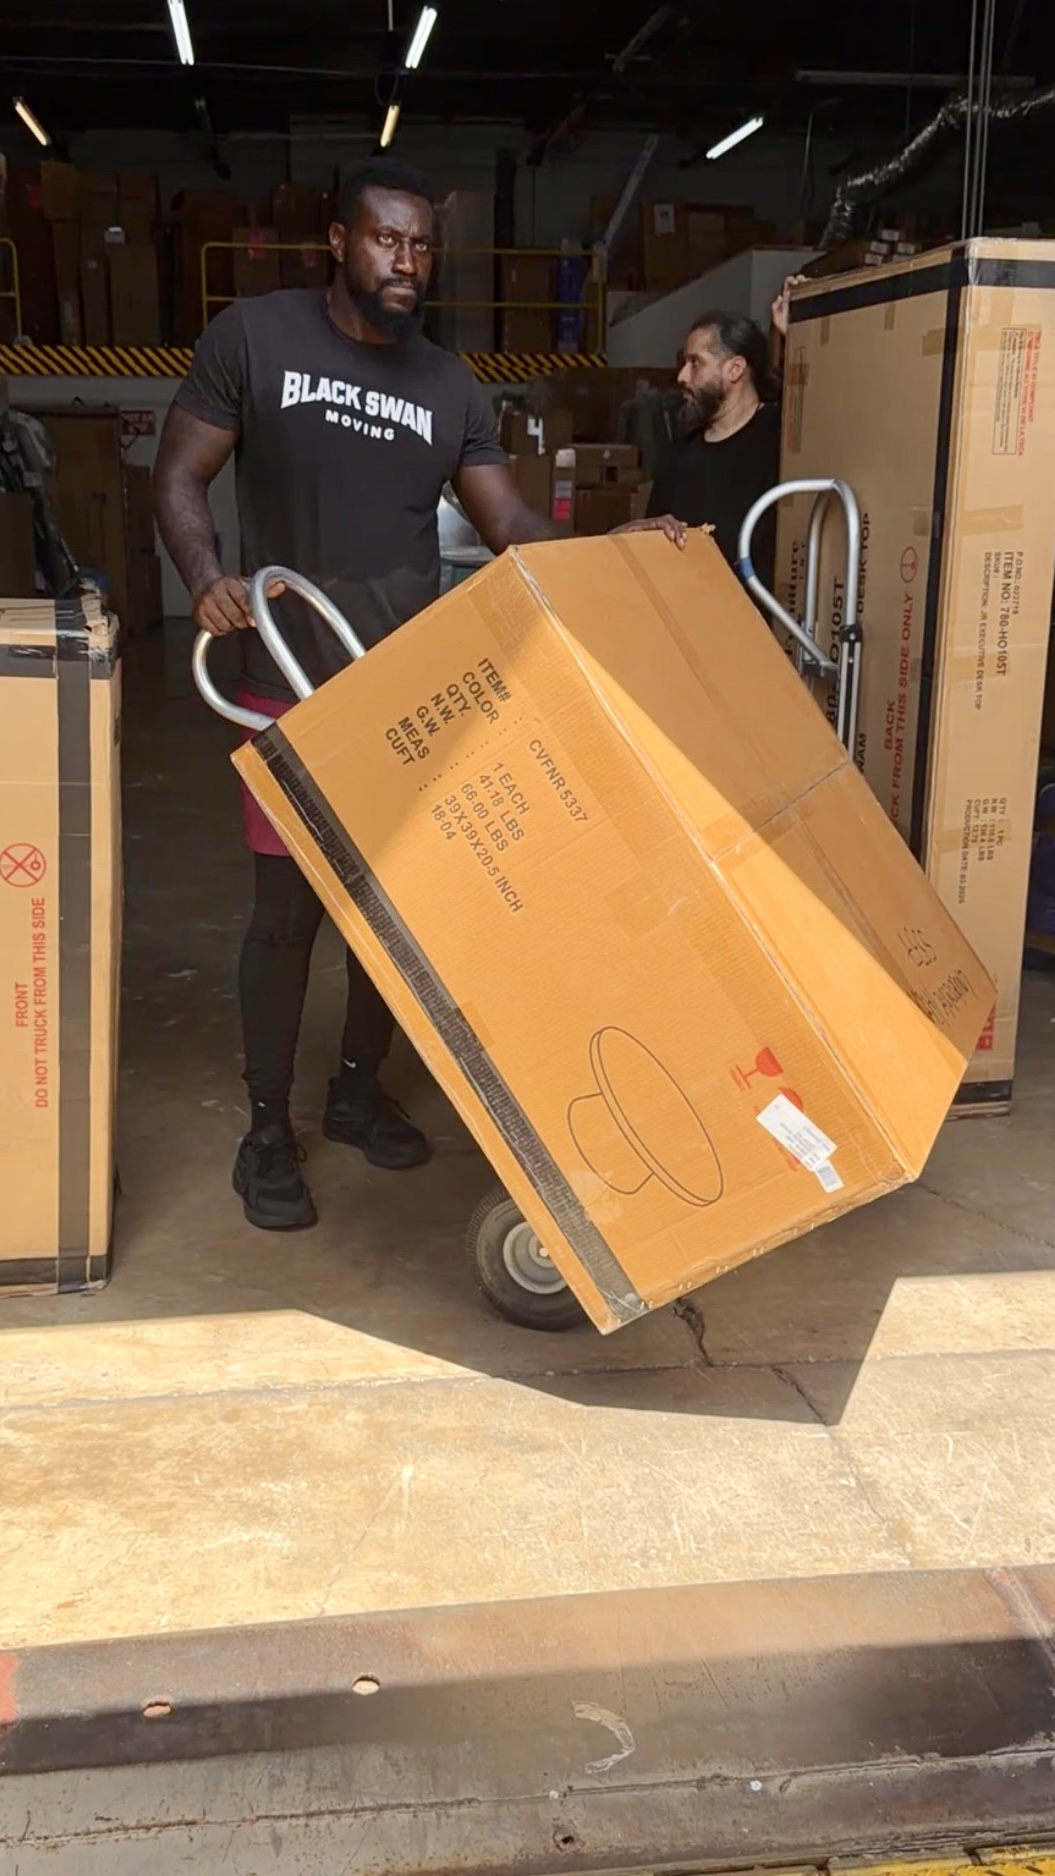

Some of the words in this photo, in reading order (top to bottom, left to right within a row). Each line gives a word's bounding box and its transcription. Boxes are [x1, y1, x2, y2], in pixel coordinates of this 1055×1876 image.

[281, 371, 361, 410] BLACK
[365, 391, 432, 446] SWAN
[325, 410, 394, 440] MOVING
[859, 513, 871, 550] TOP
[981, 552, 991, 608] DESCRIPTION:
[1003, 552, 1013, 579] ITEM
[784, 540, 799, 656] Fniture
[980, 610, 988, 621] JR
[1001, 583, 1011, 603] NO:
[901, 593, 914, 641] ONLY
[977, 623, 987, 668] EXECUTIVE
[996, 607, 1009, 676] 780-HO105T
[899, 645, 910, 688] SIDE
[975, 669, 984, 692] DESK
[462, 672, 499, 724] COLOR
[897, 693, 907, 731] THIS
[478, 658, 511, 702] ITEM#
[529, 740, 566, 791] CVFNR
[560, 791, 588, 823] 5337
[884, 699, 896, 750] BACK
[431, 693, 455, 724] N.W.
[480, 774, 504, 807] 41.18
[500, 811, 524, 841] LBS
[446, 684, 471, 716] QTY.
[499, 773, 530, 815] EACH
[892, 738, 905, 789] FROM
[386, 728, 415, 766] CUFT
[432, 805, 456, 840] 18.04
[416, 706, 440, 736] G.W.
[461, 784, 489, 819] 66.00
[485, 821, 509, 851] LBS
[398, 717, 430, 760] MEAS
[445, 795, 500, 876] 39X39X20.5
[495, 876, 523, 913] INCH
[963, 800, 972, 849] PRODUCTION
[997, 836, 1004, 846] PC
[32, 898, 45, 928] SIDE
[33, 933, 45, 963] THIS
[15, 983, 28, 1027] FRONT
[34, 967, 46, 1005] FROM
[35, 1009, 47, 1054] TRUCK
[35, 1059, 47, 1084] NOT
[36, 1089, 48, 1108] DO
